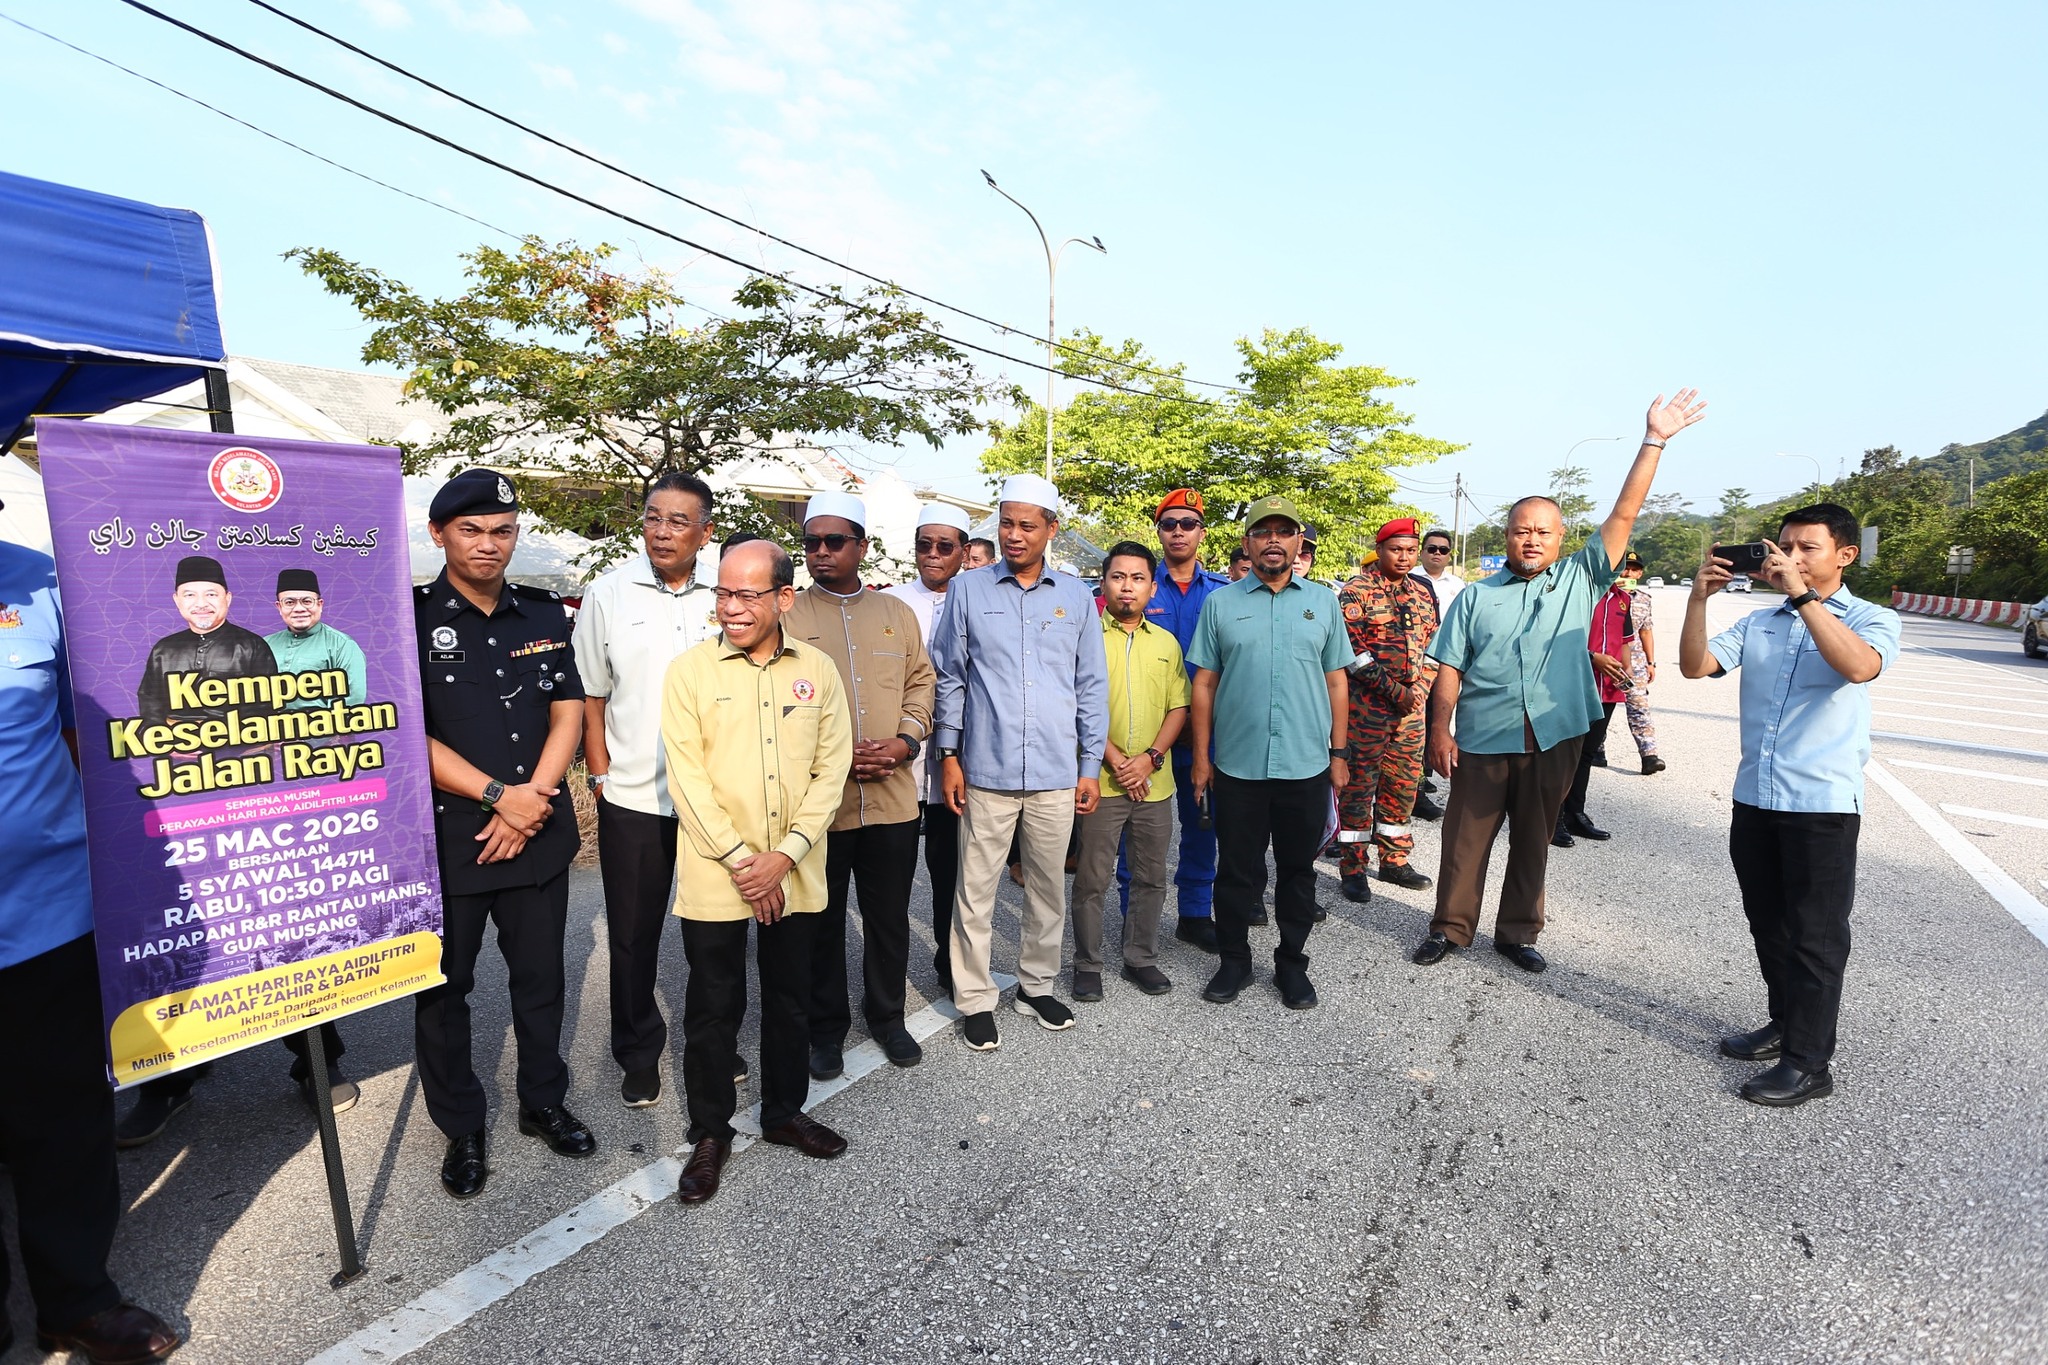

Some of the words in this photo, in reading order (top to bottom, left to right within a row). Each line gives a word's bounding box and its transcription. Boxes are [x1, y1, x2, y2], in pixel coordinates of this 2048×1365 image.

[89, 516, 135, 555] راي
[146, 518, 207, 550] جالن
[166, 668, 348, 712] Kempen
[108, 700, 398, 760] Keselamatan
[139, 751, 273, 799] Jalan
[282, 740, 384, 781] Raya
[159, 815, 225, 833] PERAYAAN
[228, 811, 257, 822] HARI
[260, 806, 290, 818] RAYA
[293, 797, 346, 811] AIDILFITRI
[349, 791, 378, 803] 1447H
[225, 796, 280, 811] SEMPENA
[284, 789, 321, 802] MUSIM
[164, 837, 206, 867] 25
[216, 823, 296, 858] MAC
[303, 809, 379, 842] 2026
[228, 842, 330, 871] BERSAMAAN
[164, 893, 252, 928] RABU,
[257, 878, 325, 907] 10:30
[332, 864, 389, 892] PAGI
[178, 883, 193, 900] 5
[199, 862, 307, 896] SYAWAL
[311, 848, 375, 874] 1447H
[123, 922, 236, 963] HADAPAN
[240, 913, 285, 935] R&R
[287, 893, 367, 924] RANTAU
[371, 881, 433, 905] MANIS,
[222, 936, 269, 955] GUA
[273, 913, 357, 943] MUSANG
[156, 987, 243, 1021] SELAMAT
[247, 976, 289, 996] HARI
[293, 963, 343, 985] RAYA
[343, 943, 415, 972] AIDILFITRI
[206, 997, 259, 1022] MAAF
[263, 983, 314, 1006] ZAHIR
[318, 979, 330, 991] &
[334, 965, 380, 987] BATIN
[180, 1024, 268, 1056] Keselamatan
[272, 1012, 303, 1029] Jalan
[381, 973, 427, 994] Kelantan
[241, 1008, 280, 1026] Ikhlas
[284, 992, 337, 1014] Daripada
